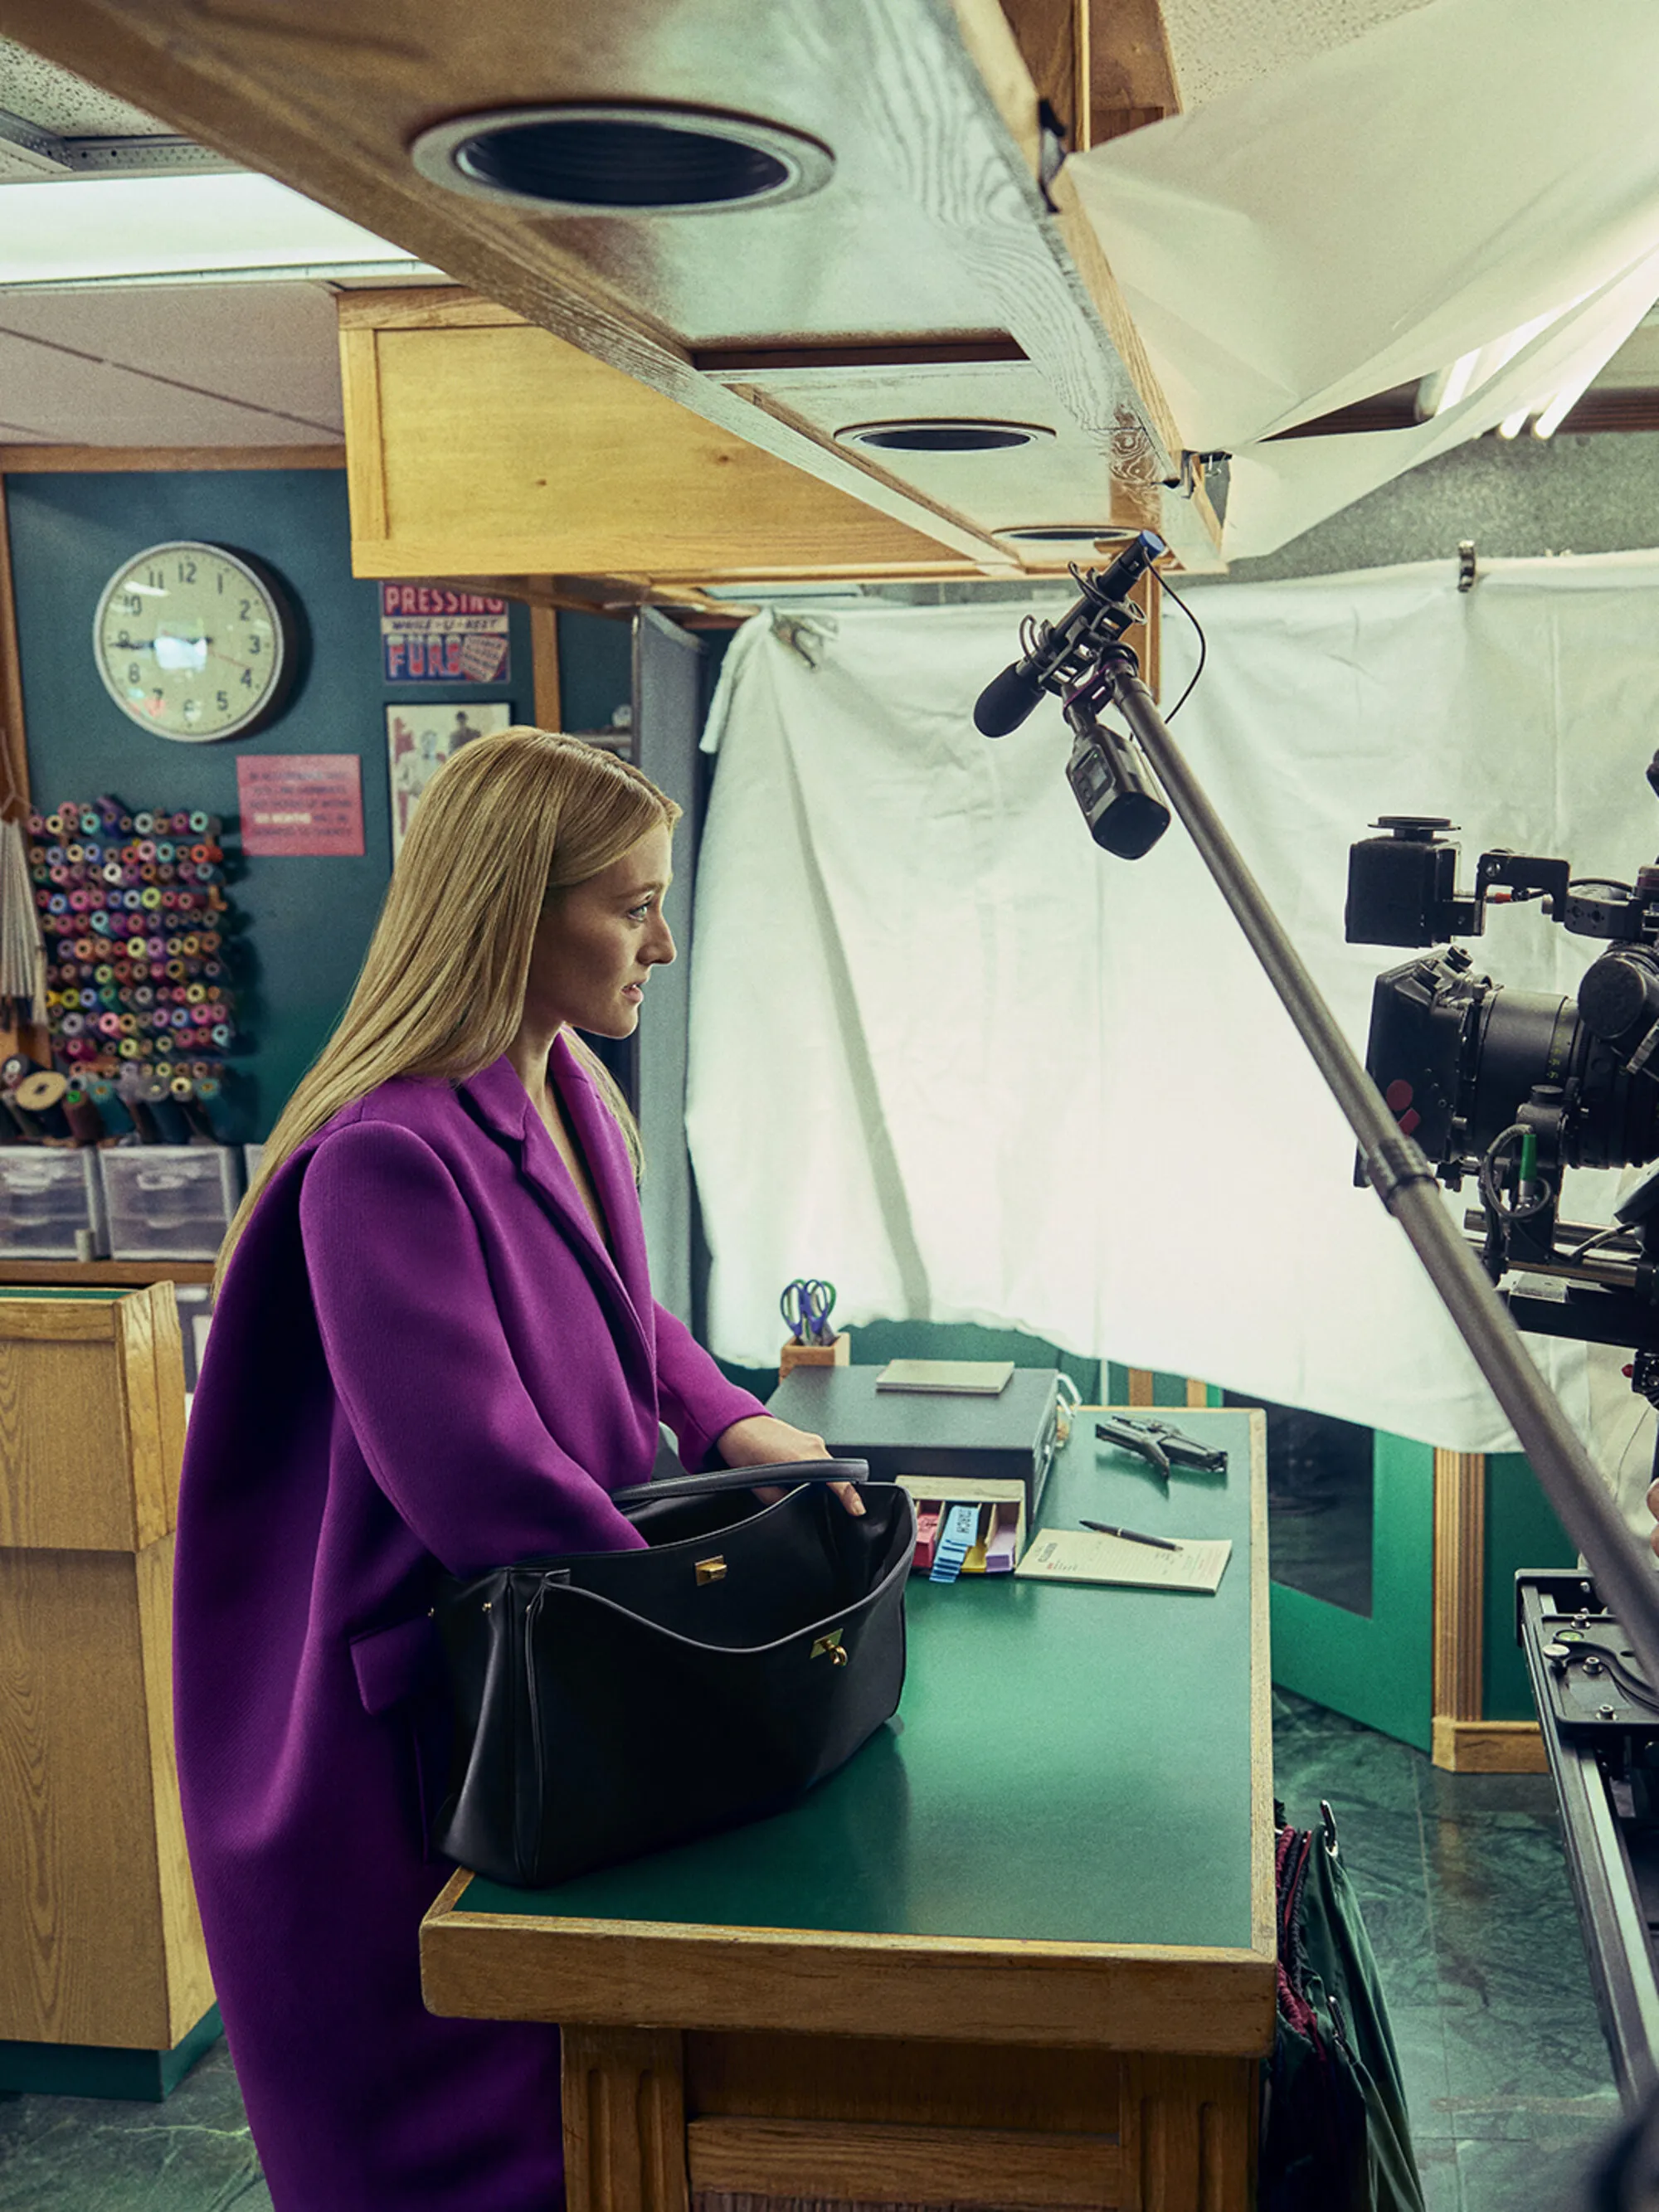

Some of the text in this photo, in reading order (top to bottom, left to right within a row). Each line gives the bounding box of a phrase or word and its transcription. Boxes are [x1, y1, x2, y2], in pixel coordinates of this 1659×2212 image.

[149, 571, 163, 590] 11
[178, 562, 197, 584] 12
[216, 573, 223, 594] 1
[239, 599, 251, 621] 2
[249, 634, 261, 654] 3
[388, 635, 462, 678] FURS
[128, 663, 141, 683] 8
[240, 668, 252, 688] 4
[152, 688, 164, 710] 7
[216, 690, 229, 711] 5
